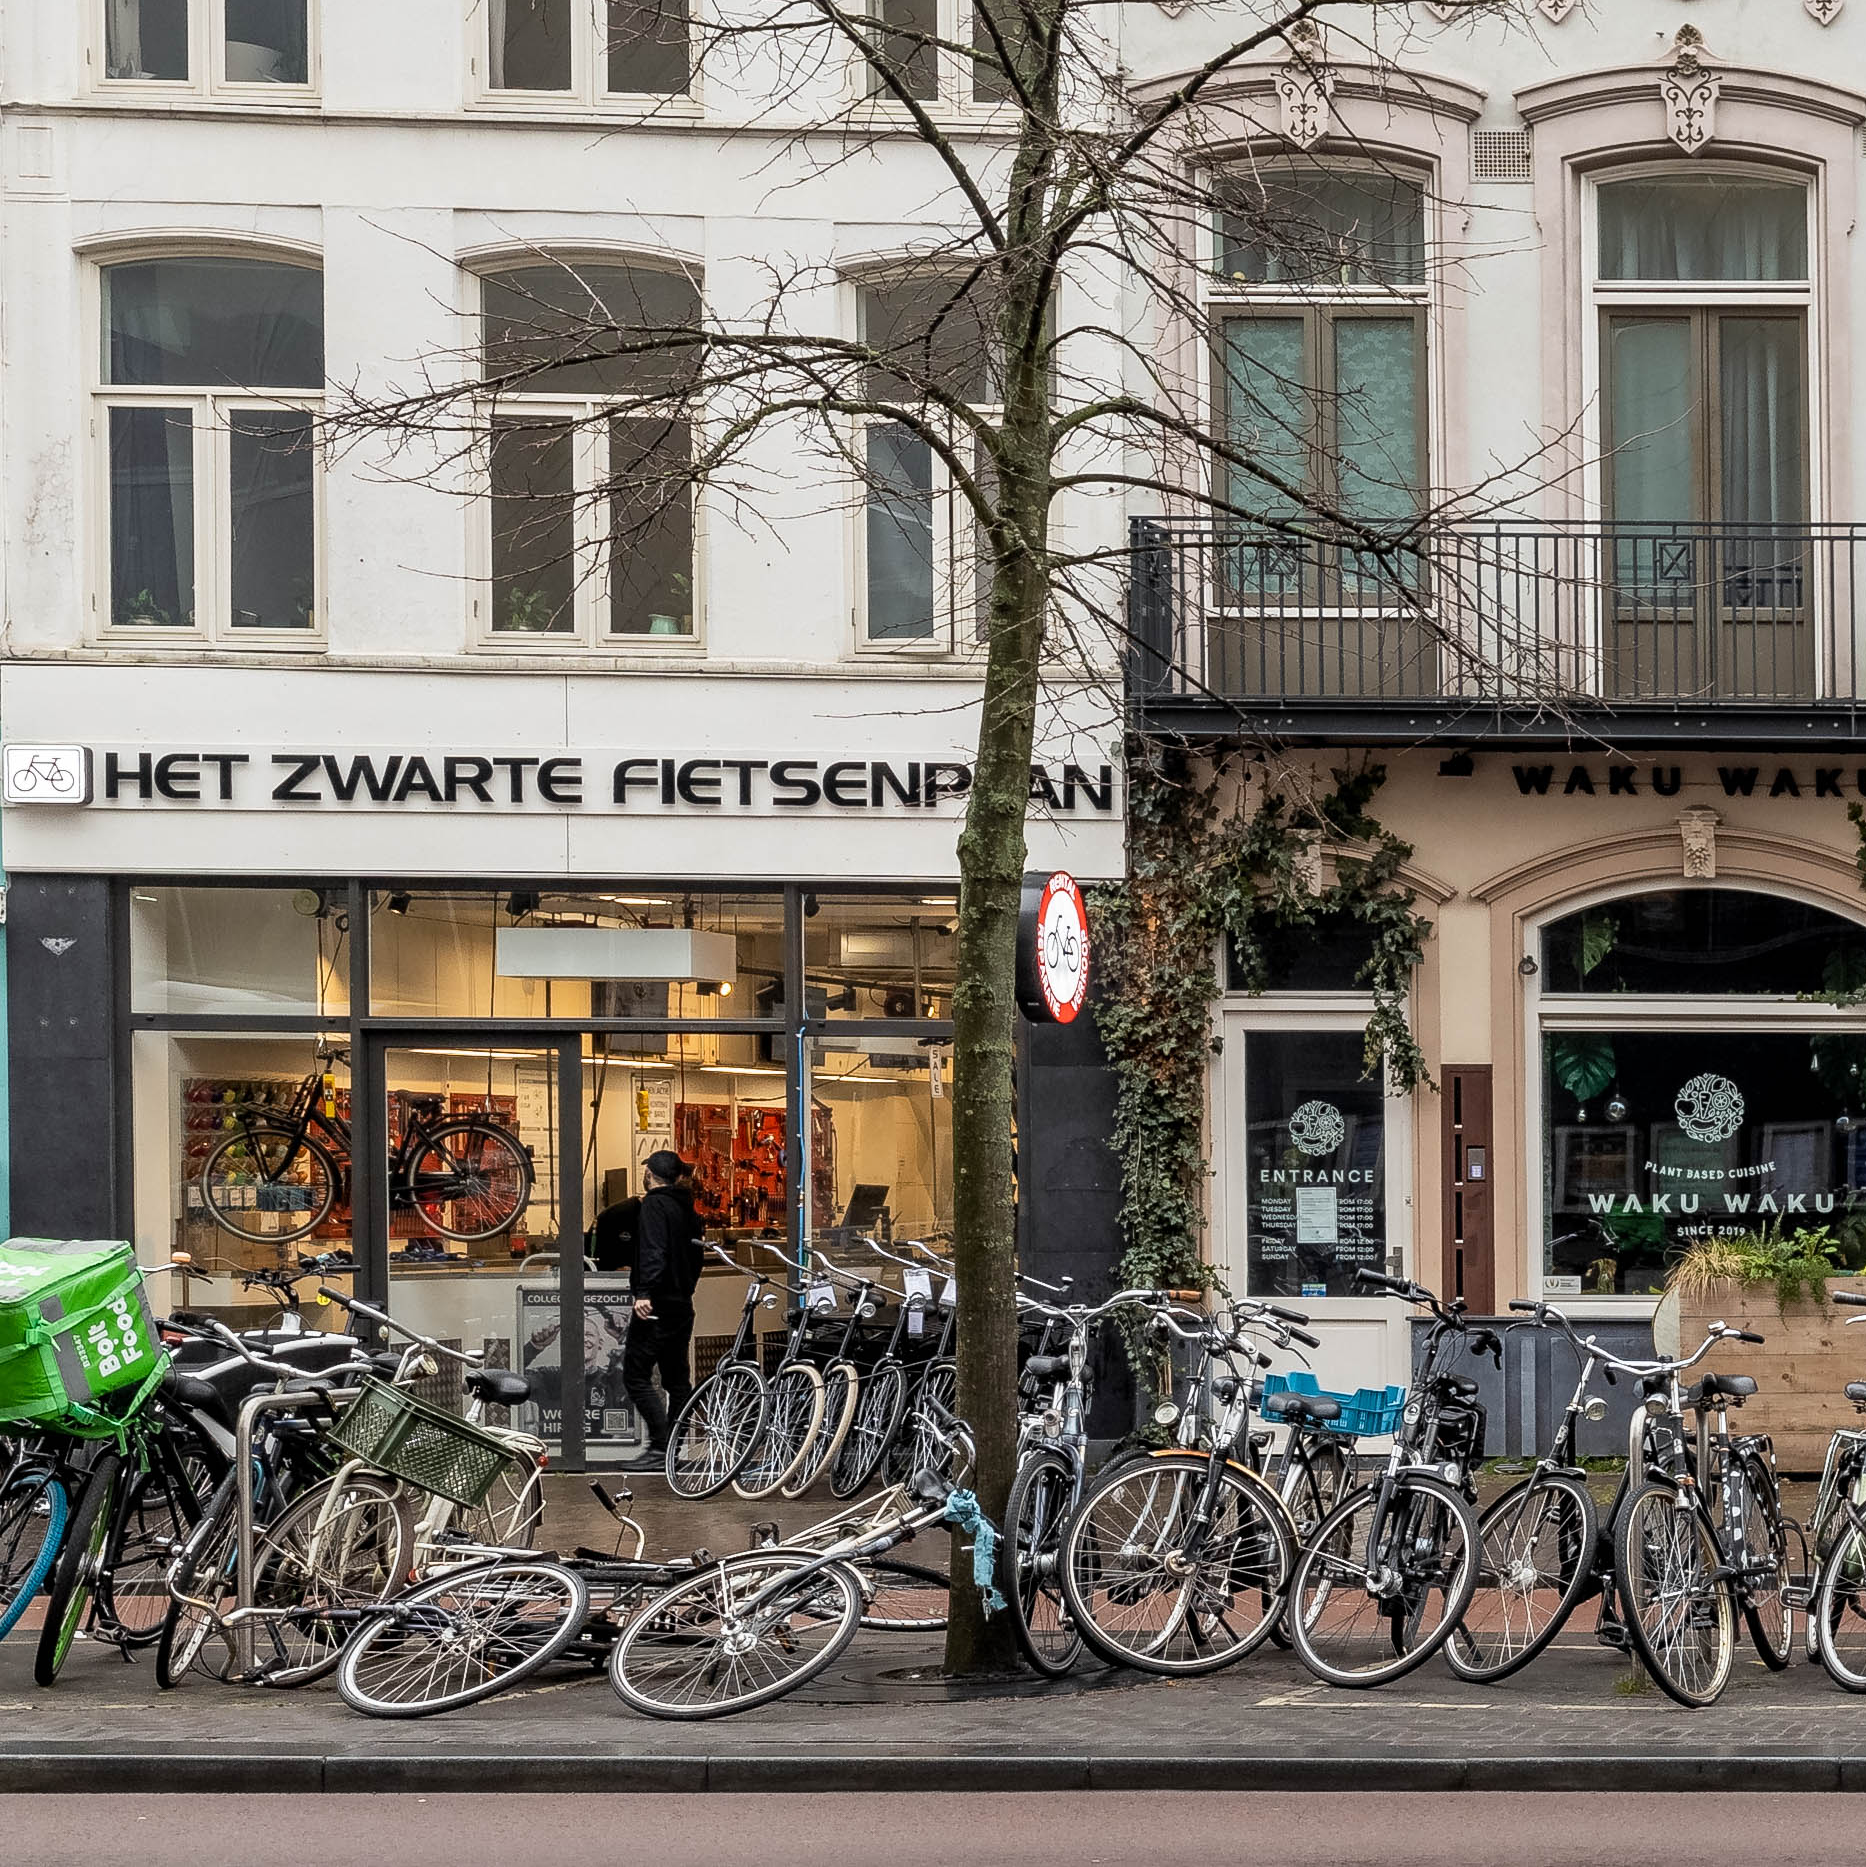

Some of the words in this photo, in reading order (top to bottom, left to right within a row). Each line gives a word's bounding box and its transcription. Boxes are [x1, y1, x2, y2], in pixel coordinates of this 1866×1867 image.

[105, 752, 249, 800] HET
[271, 755, 583, 804] ZWARTE
[613, 758, 1112, 811] FIETSENPAN
[1512, 765, 1682, 796] WAKU
[1260, 1169, 1374, 1183] ENTRANCE
[1644, 1161, 1683, 1178] PLANT
[1686, 1169, 1724, 1180] BASED
[1728, 1161, 1777, 1179] CUISINE
[1588, 1193, 1700, 1213] WAKU
[1724, 1193, 1835, 1213] WAKU
[1677, 1226, 1713, 1236] SINCE
[1718, 1225, 1746, 1236] 2019
[584, 1294, 629, 1303] GEZOCHT
[106, 1297, 144, 1365] Food
[87, 1320, 122, 1378] Bolt
